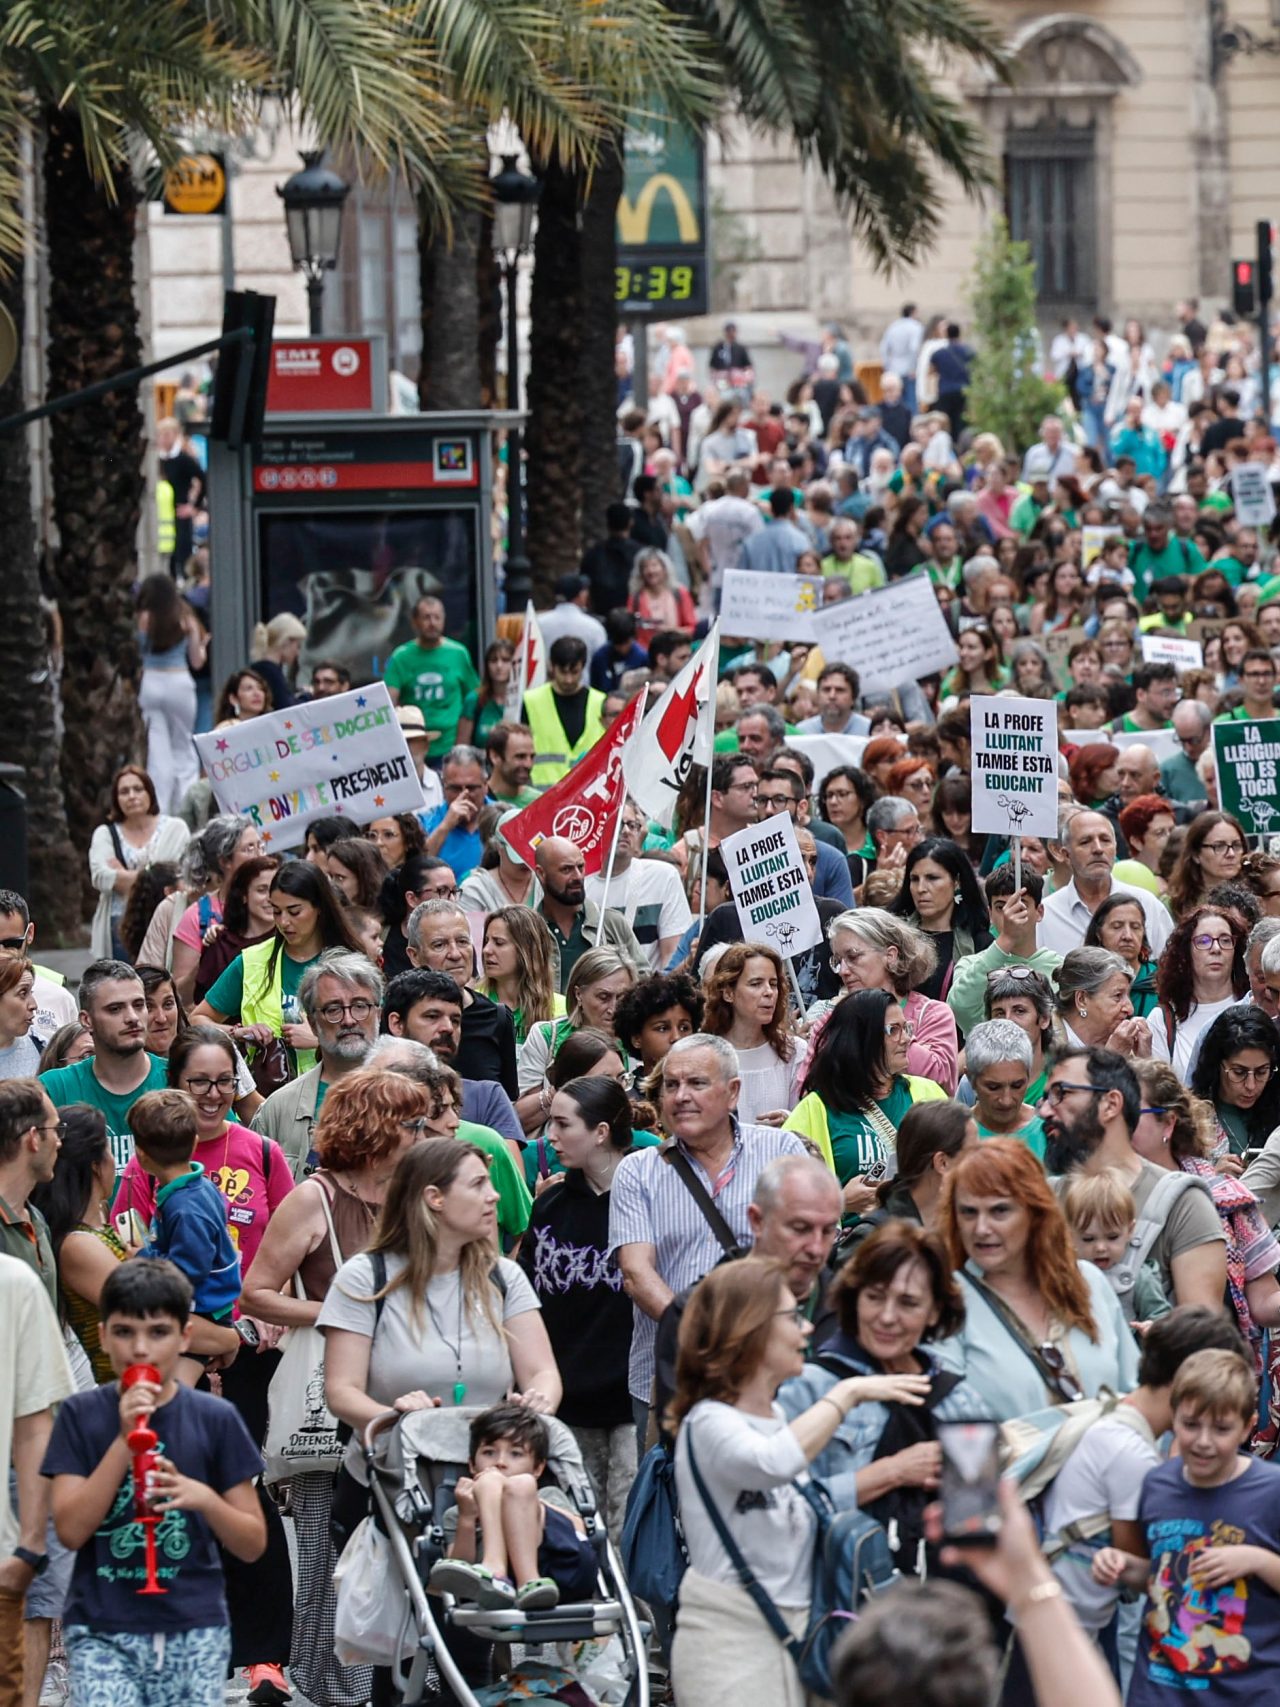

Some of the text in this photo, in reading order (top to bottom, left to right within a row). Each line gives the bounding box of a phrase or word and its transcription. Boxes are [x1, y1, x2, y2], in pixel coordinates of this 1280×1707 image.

[275, 349, 320, 360] EMT
[275, 735, 302, 760] DE
[301, 727, 332, 751] SER
[334, 705, 393, 740] DOCENT
[984, 712, 1043, 732] LA PROFE
[985, 733, 1043, 752] LLUITANT
[1244, 726, 1262, 743] LA
[976, 752, 1053, 774] TAMBÉ ESTÀ
[1235, 760, 1277, 780] NO ES
[985, 773, 1044, 793] EDUCANT
[1238, 778, 1278, 797] TOCA
[735, 831, 786, 866] LA PROFE
[740, 850, 790, 886] LLUITANT
[737, 864, 805, 909] TAMBÉ ESTÀ
[750, 890, 801, 925] EDUCANT
[857, 1134, 876, 1164] LA
